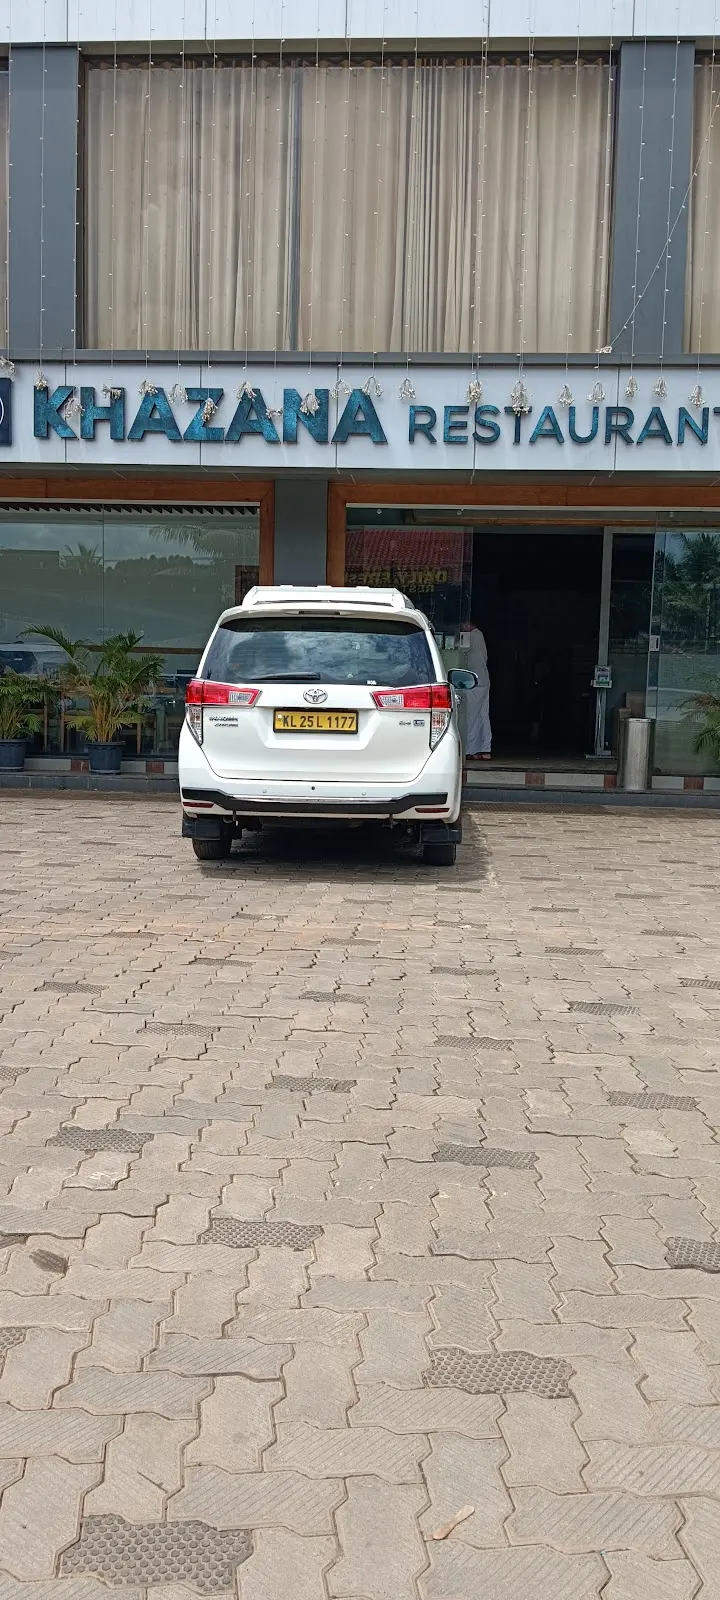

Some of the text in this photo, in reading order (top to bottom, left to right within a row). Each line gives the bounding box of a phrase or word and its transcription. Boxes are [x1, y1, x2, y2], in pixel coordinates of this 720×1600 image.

[33, 385, 720, 445] KHAZANA RESTAURAN
[283, 715, 355, 728] KL 25 L 1177
